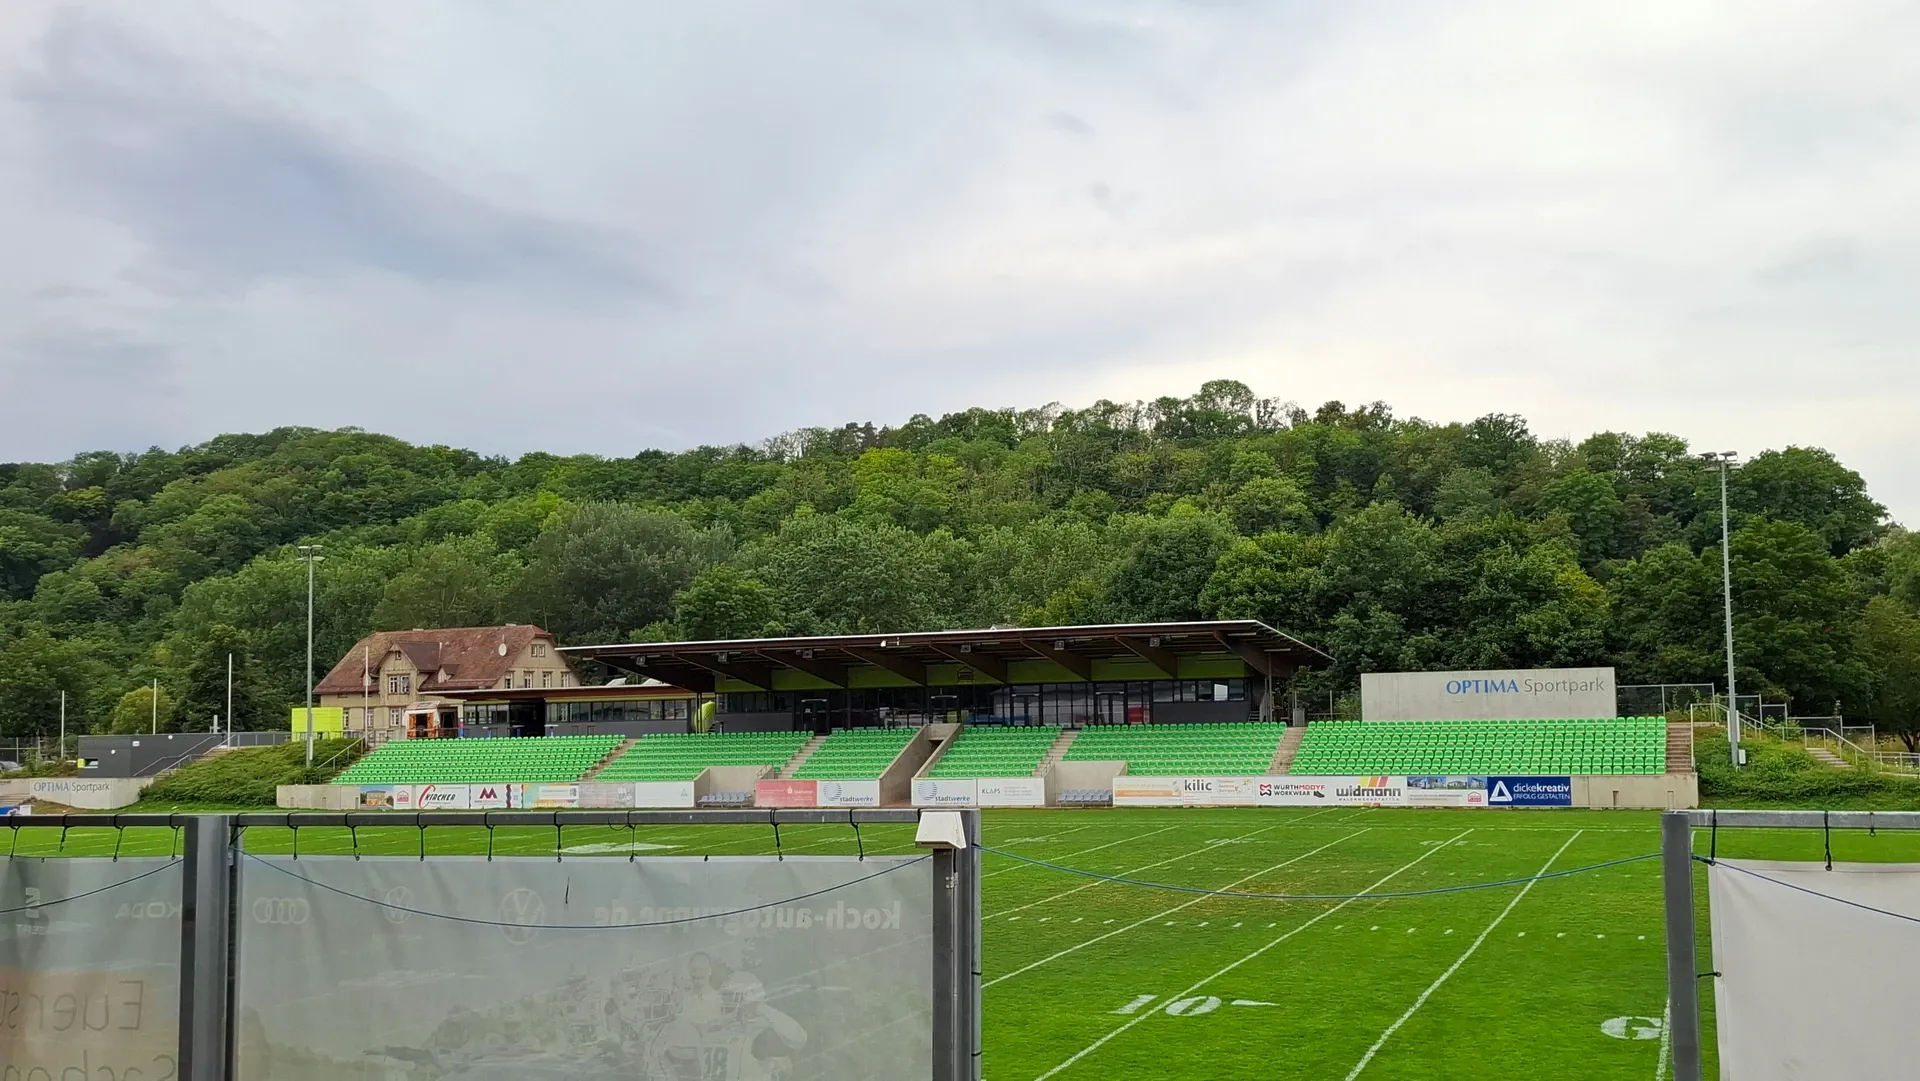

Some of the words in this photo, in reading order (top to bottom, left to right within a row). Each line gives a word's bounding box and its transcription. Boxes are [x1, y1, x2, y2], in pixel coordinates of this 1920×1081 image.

[1446, 679, 1519, 695] OPTIMA
[1524, 677, 1604, 696] Sportpark
[34, 781, 69, 792] OPTIMA
[71, 781, 109, 793] Sportpark
[1184, 779, 1212, 791] kilic
[1336, 785, 1401, 797] widmann
[1513, 783, 1569, 792] dickekreativ
[839, 795, 874, 803] stadtwerke
